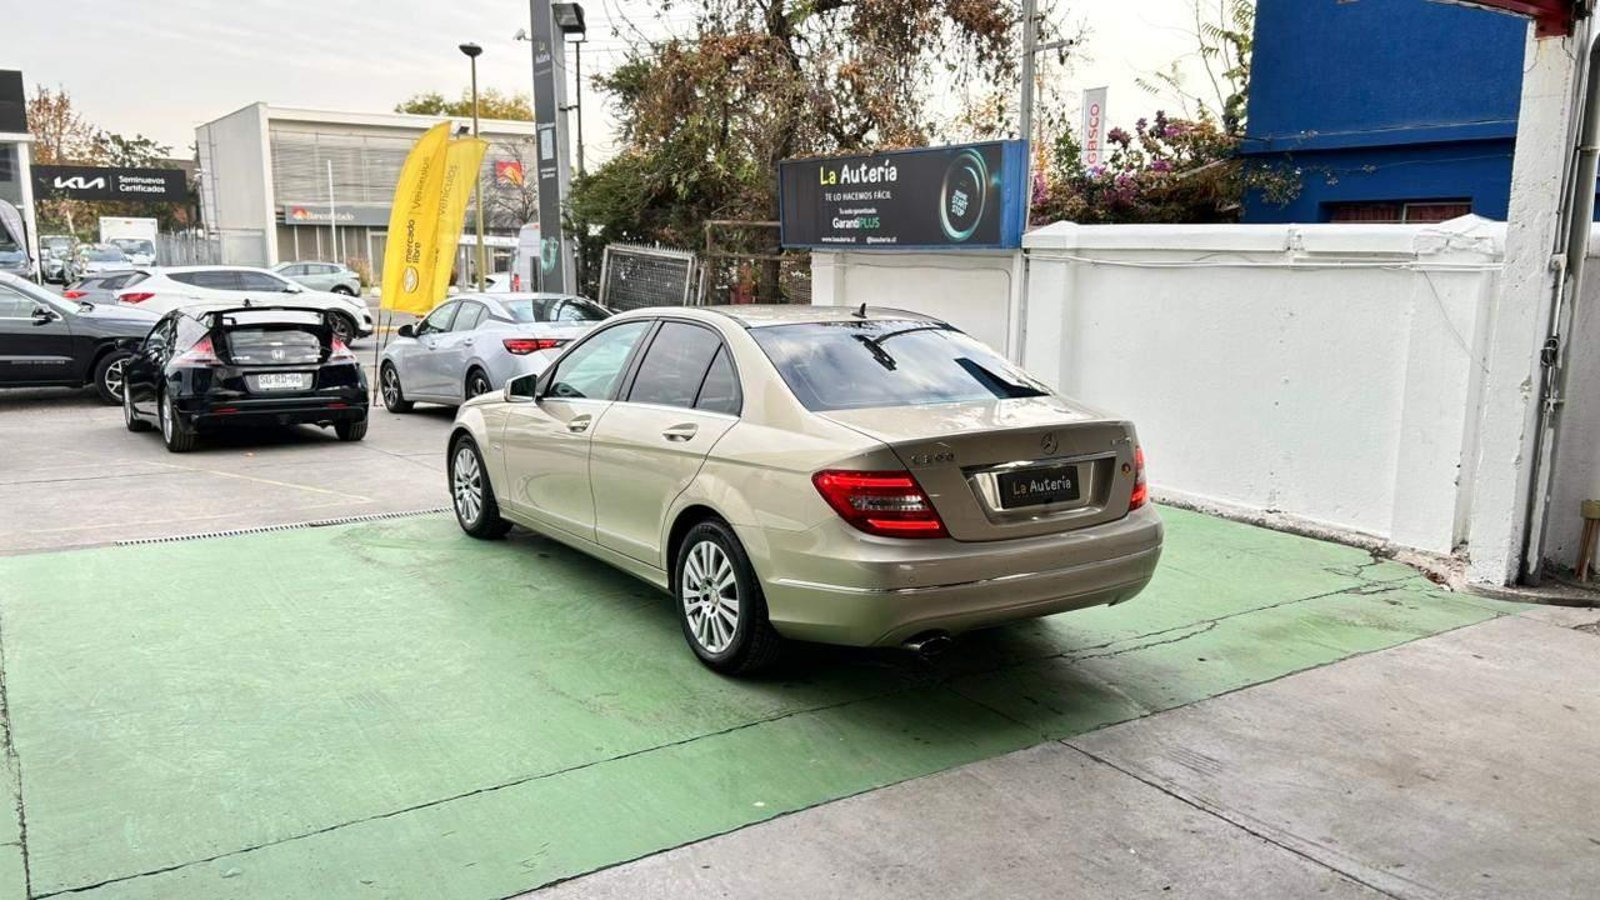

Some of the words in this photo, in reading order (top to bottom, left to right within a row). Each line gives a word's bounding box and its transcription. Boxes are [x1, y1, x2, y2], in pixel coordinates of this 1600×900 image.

[118, 175, 165, 184] Seminuevos
[820, 166, 836, 185] La
[840, 159, 897, 184] Autería
[119, 184, 166, 193] Certificados
[405, 219, 415, 263] mercado
[412, 242, 421, 263] libre
[1013, 481, 1027, 495] La
